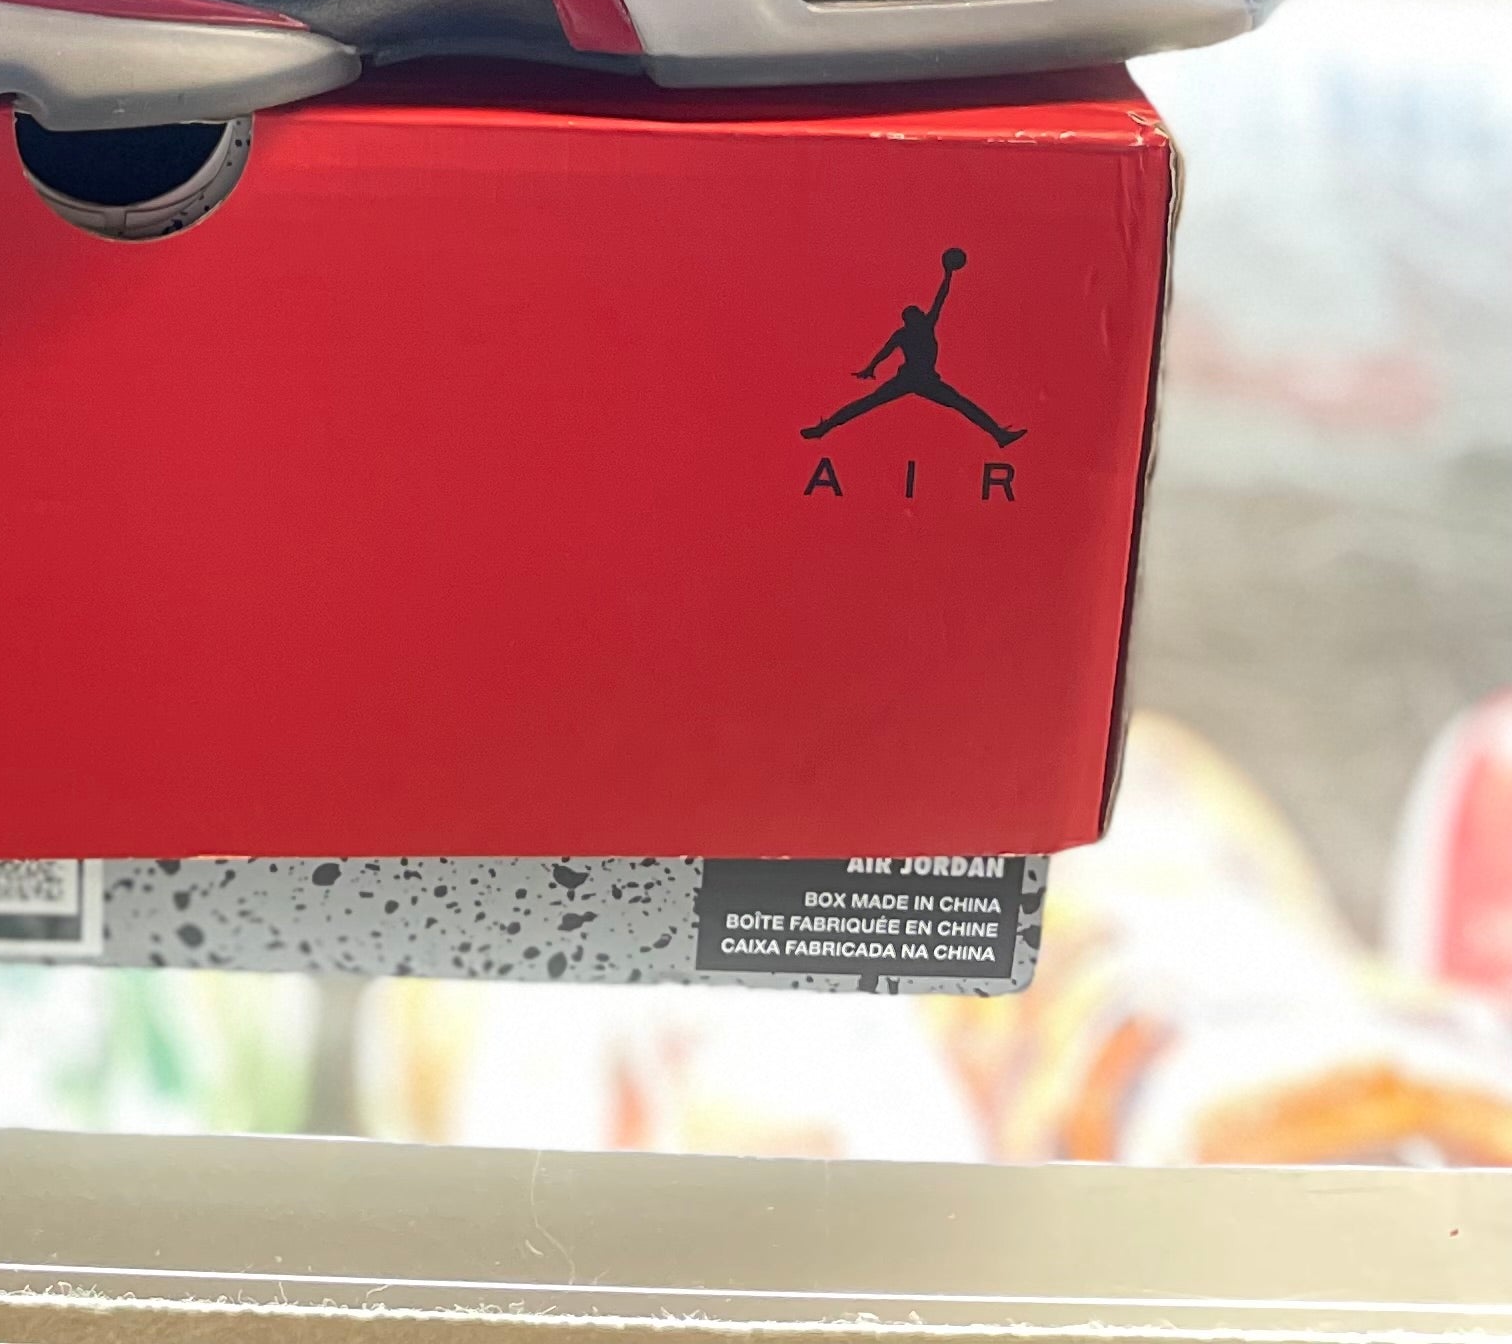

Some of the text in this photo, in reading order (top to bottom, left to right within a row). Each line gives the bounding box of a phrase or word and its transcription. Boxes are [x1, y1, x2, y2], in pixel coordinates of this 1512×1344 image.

[803, 457, 1016, 501] AIR
[847, 856, 1005, 878] AIR JORDAN
[804, 891, 1002, 913] BOX MADE IN CHINA
[725, 912, 999, 938] BOÎTE FABRIQUÉE EN CHINE
[720, 938, 996, 962] CAIXA FABRICADA NA CHINA
